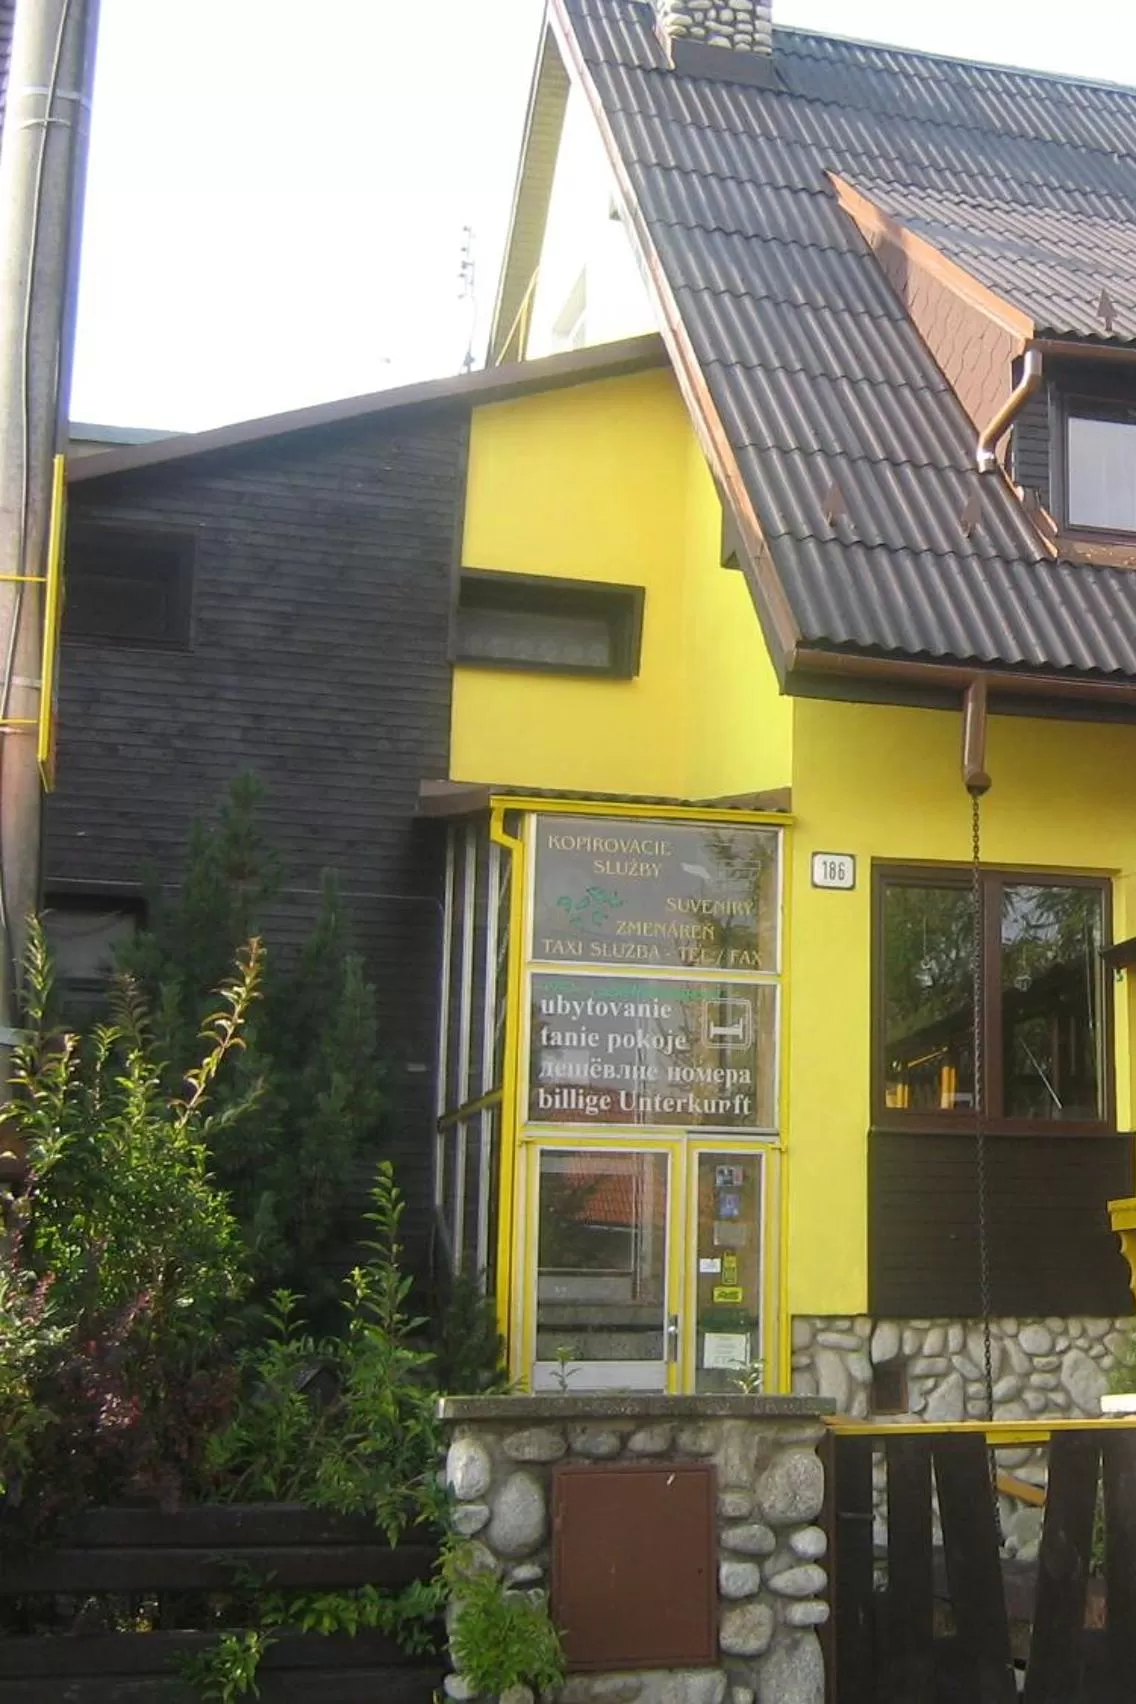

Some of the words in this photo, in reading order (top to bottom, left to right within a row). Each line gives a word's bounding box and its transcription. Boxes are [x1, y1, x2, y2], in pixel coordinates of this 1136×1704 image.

[822, 860, 846, 881] 186
[542, 939, 583, 955] TAXI
[540, 994, 672, 1021] ubytovanie
[540, 1025, 600, 1047] tanie
[607, 1028, 687, 1055] pokoje
[667, 1065, 751, 1088] номера
[538, 1088, 611, 1115] billige
[619, 1089, 752, 1115] Unterkunft
